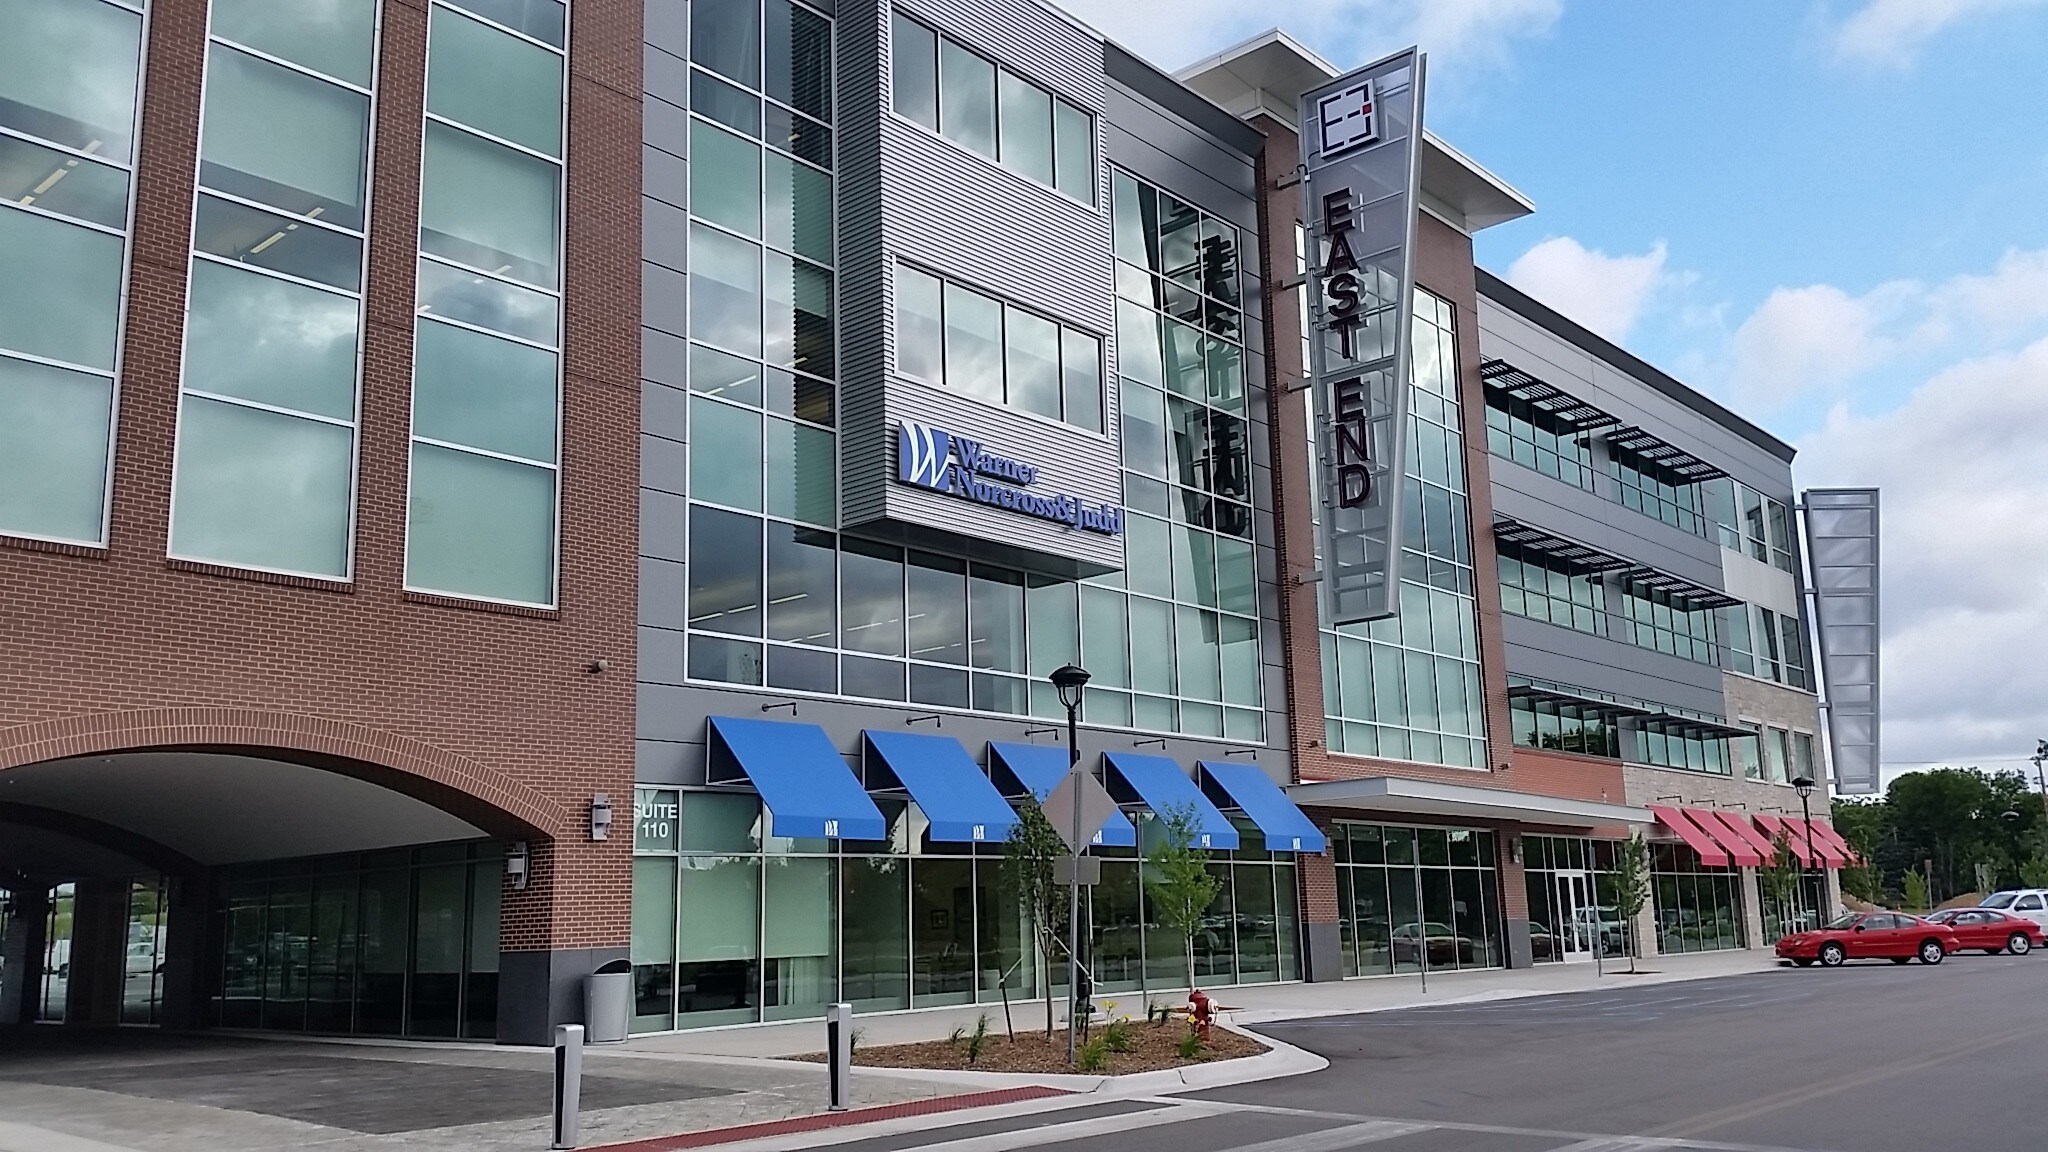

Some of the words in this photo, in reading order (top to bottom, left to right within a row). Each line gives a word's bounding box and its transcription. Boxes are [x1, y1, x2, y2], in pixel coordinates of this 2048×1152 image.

[1323, 187, 1362, 359] EAST
[953, 435, 1038, 485] Warner
[1334, 376, 1371, 508] END
[634, 803, 678, 819] SUITE
[642, 821, 669, 838] 110
